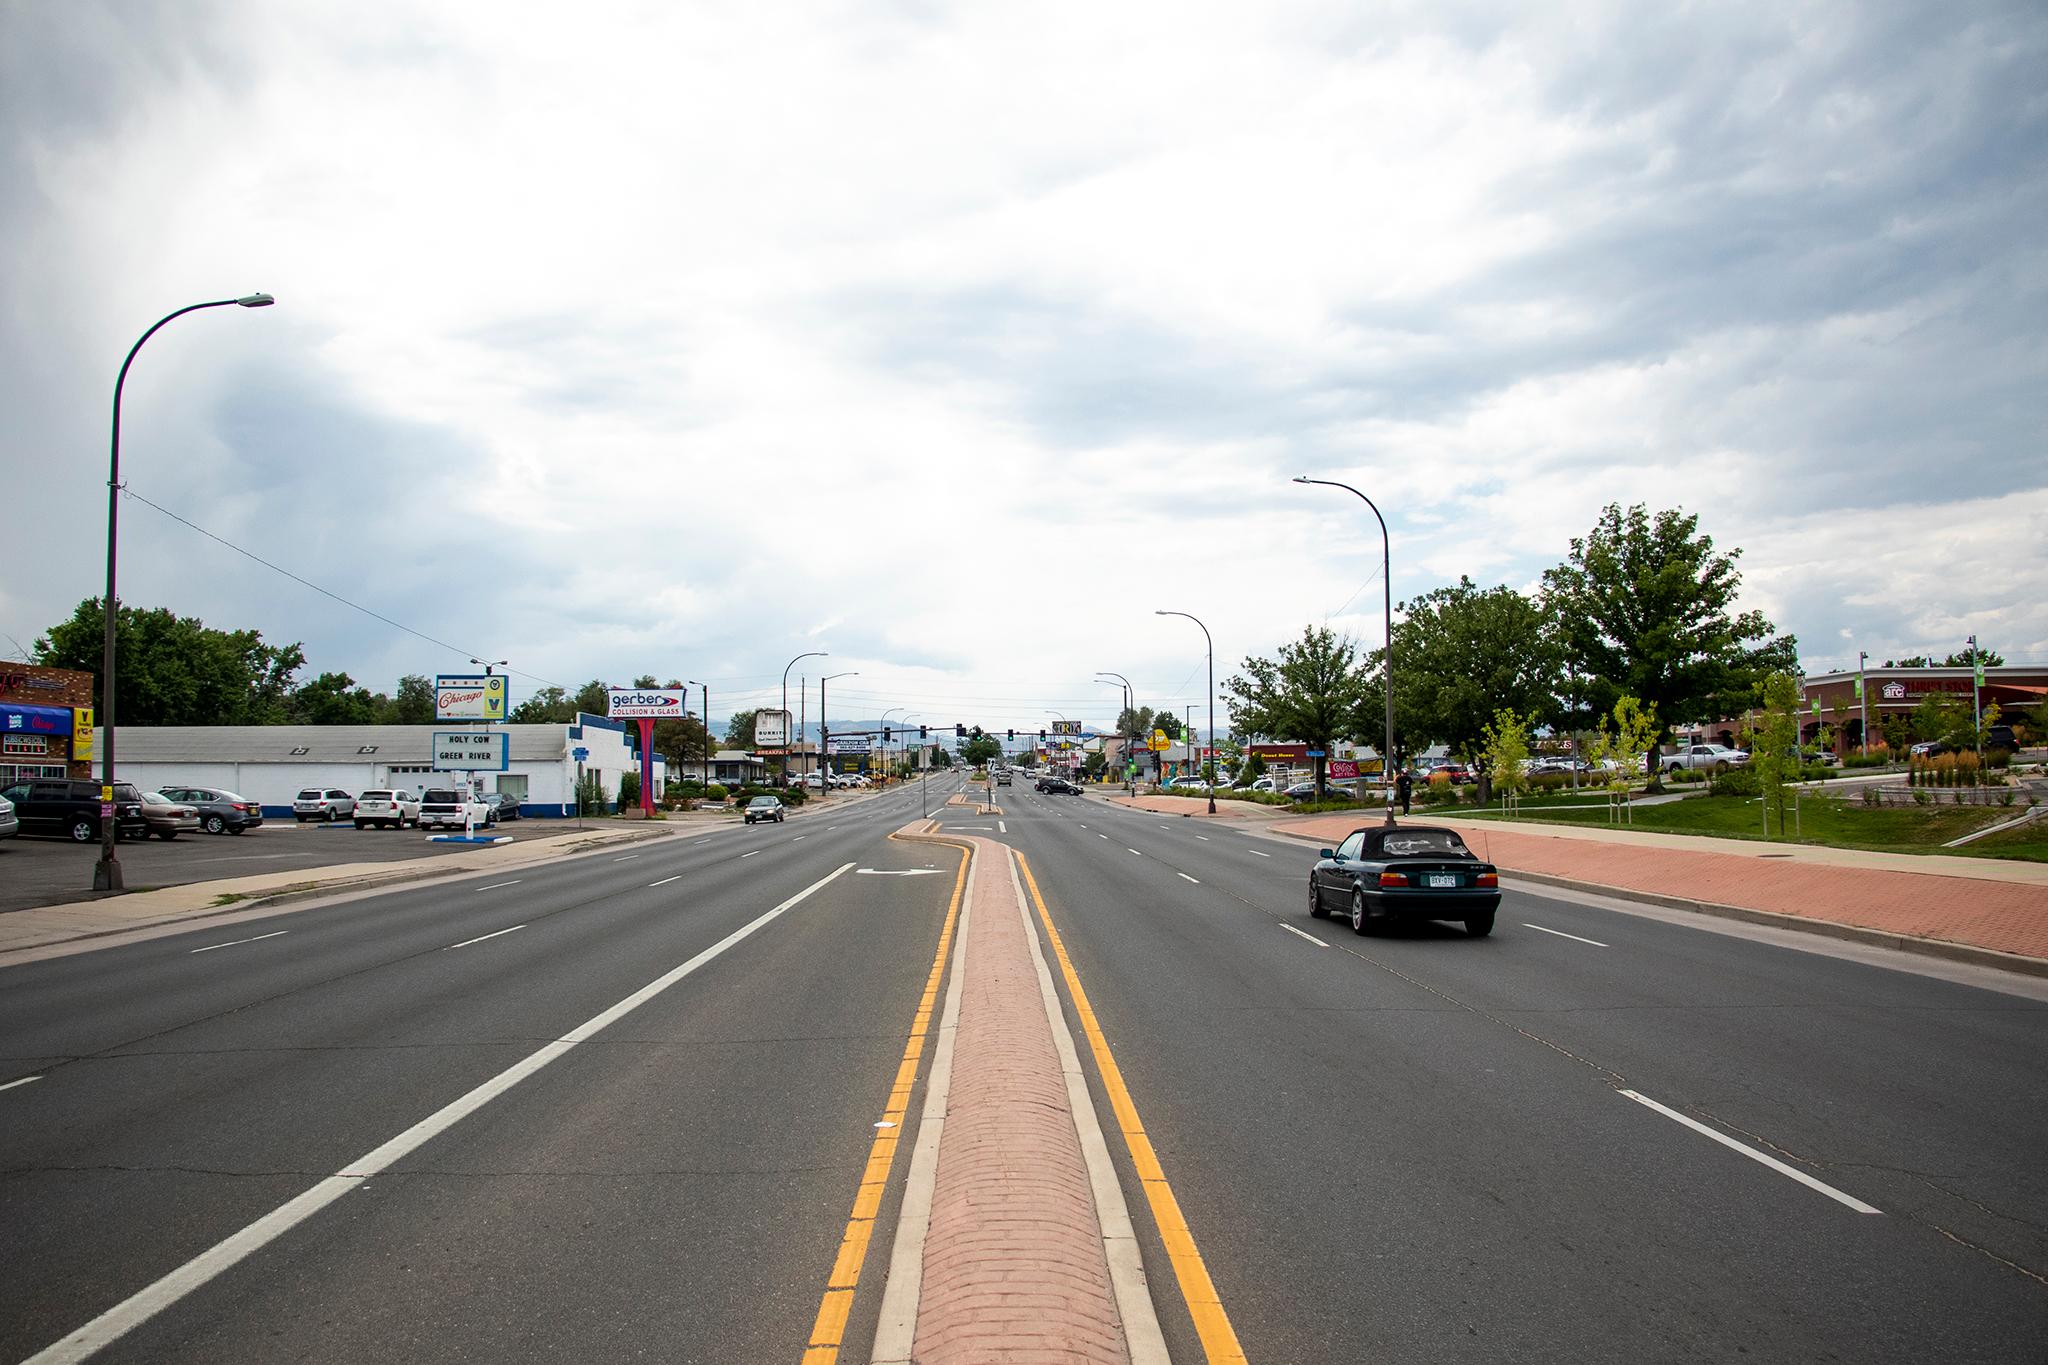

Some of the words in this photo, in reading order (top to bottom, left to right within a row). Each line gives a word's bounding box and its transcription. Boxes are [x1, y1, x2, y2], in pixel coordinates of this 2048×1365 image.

[1884, 688, 1904, 697] arc
[439, 692, 483, 709] Chicago
[612, 692, 662, 708] gerber
[449, 736, 470, 744] HOLY
[473, 736, 490, 744] COW
[439, 752, 463, 760] GREEN
[468, 752, 492, 760] RIVER
